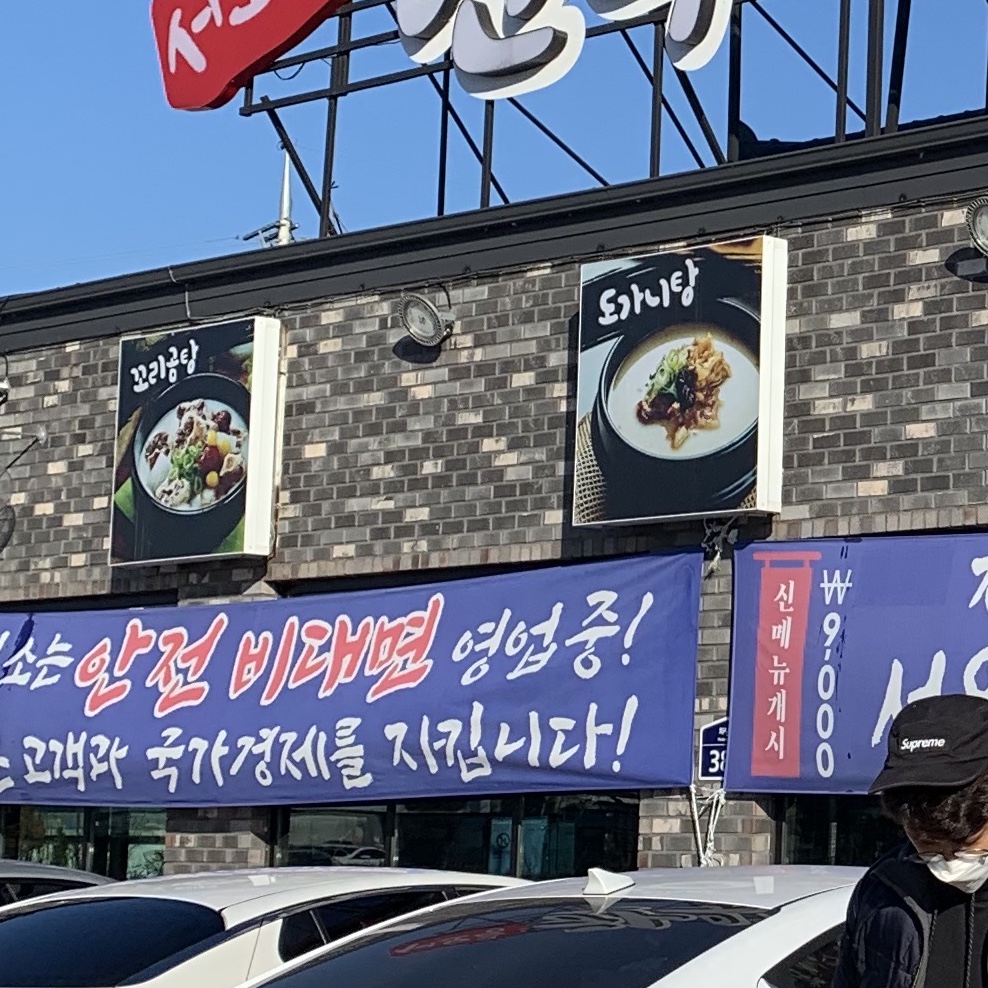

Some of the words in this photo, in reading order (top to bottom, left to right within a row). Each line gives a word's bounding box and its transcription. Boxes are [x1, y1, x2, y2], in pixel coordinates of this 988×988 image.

[598, 258, 699, 326] 도가니탕
[130, 339, 199, 393] 꼬리곰탕
[0, 630, 75, 690] 소는
[74, 612, 229, 718] 안전
[229, 592, 445, 706] 비대면
[765, 580, 795, 760] 신메뉴개시
[23, 731, 129, 792] 고객과
[384, 694, 639, 783] 지킵니다!
[900, 737, 946, 752] Supreme
